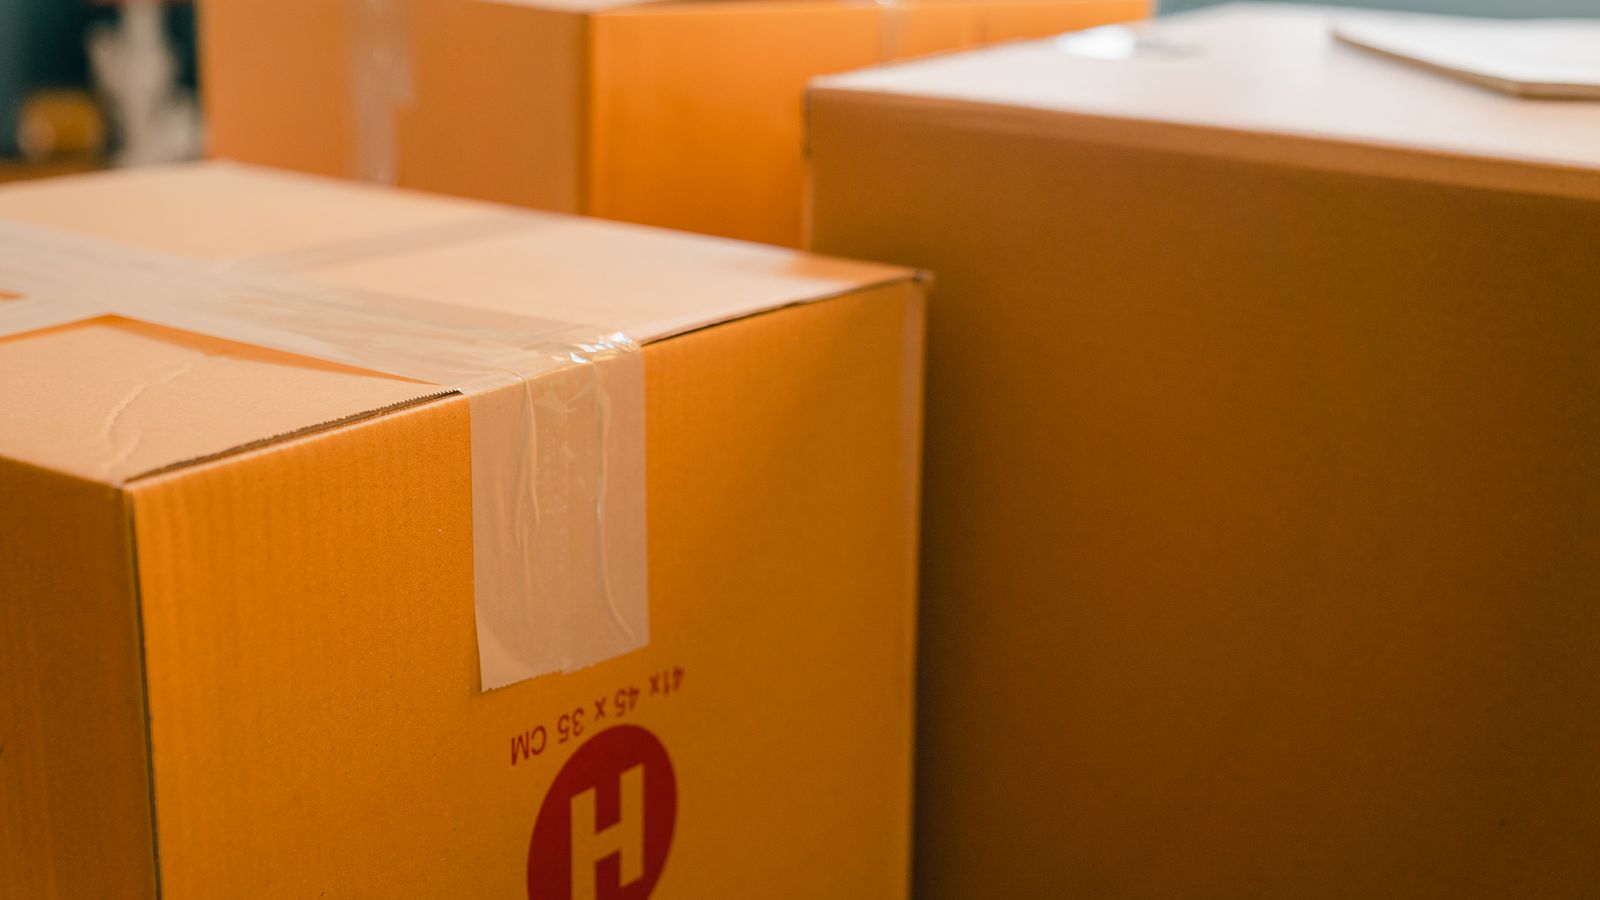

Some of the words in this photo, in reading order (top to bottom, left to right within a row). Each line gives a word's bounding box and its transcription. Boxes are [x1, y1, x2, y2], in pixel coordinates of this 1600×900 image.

[594, 697, 606, 720] x
[614, 686, 640, 717] 45
[557, 708, 584, 744] 35
[511, 725, 546, 766] CM
[570, 763, 645, 900] H
